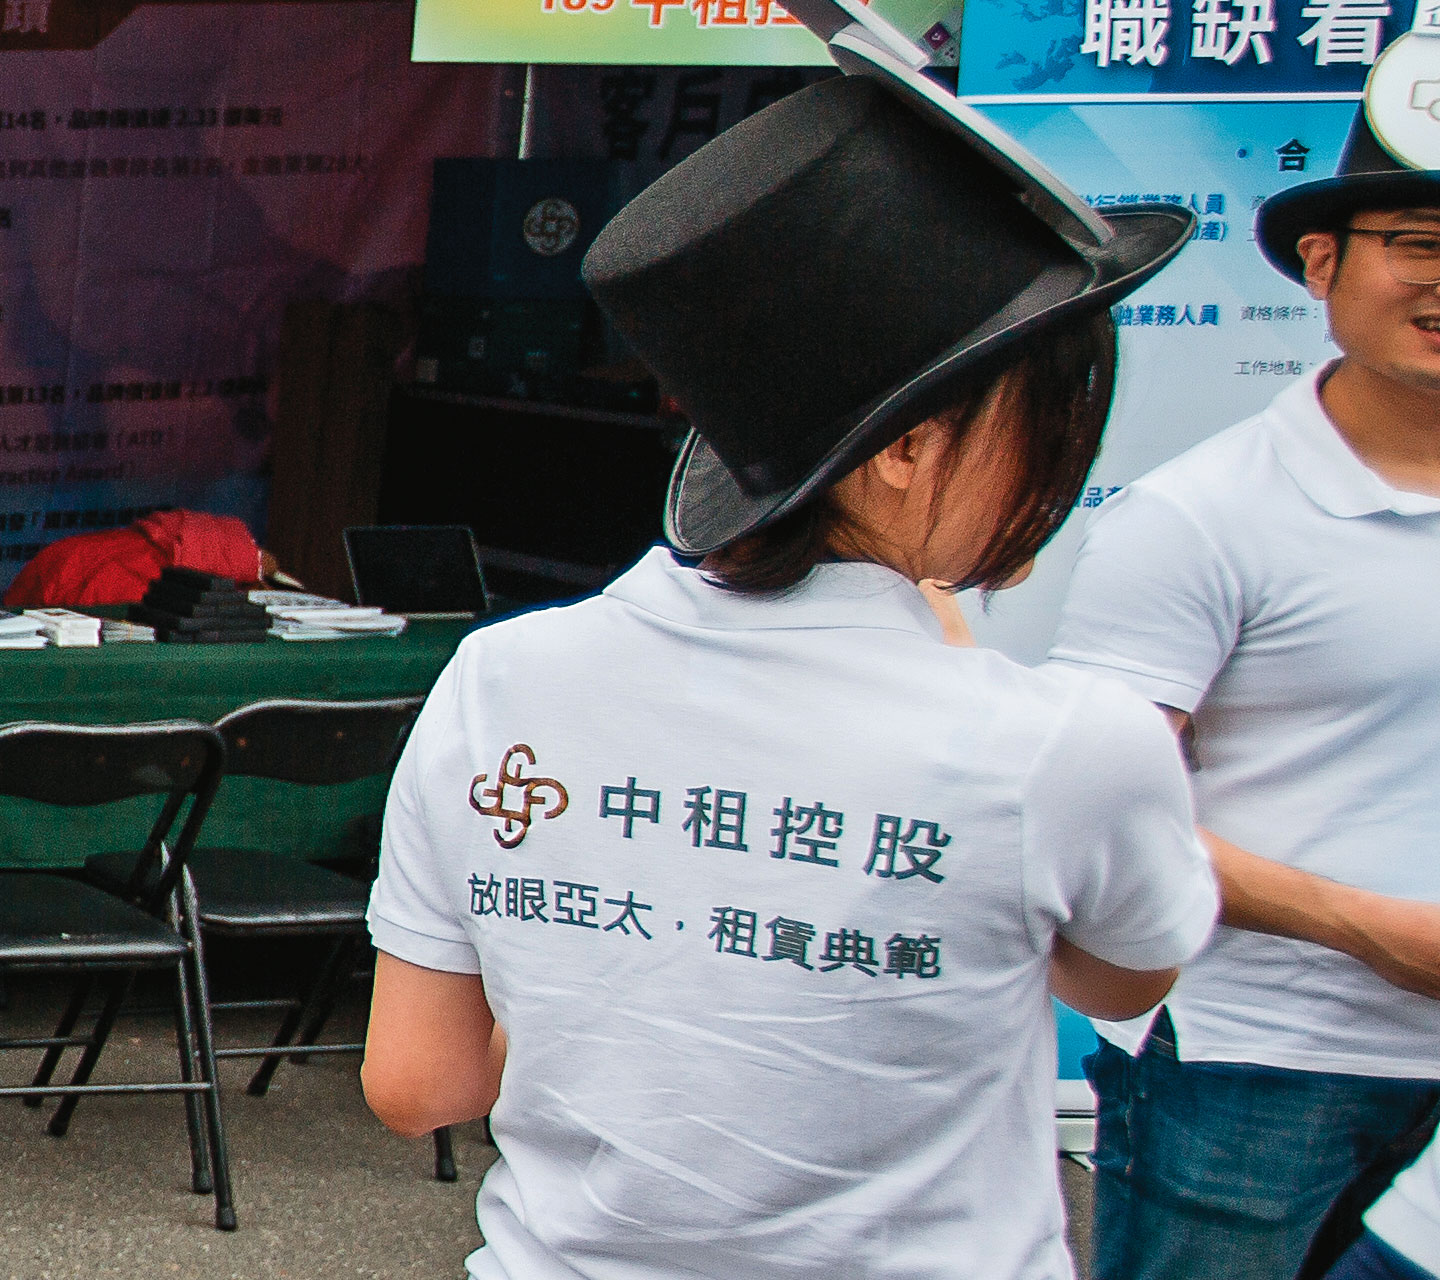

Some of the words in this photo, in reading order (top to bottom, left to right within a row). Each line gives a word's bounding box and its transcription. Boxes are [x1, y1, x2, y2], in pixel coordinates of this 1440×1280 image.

[1276, 138, 1310, 172] 合
[599, 776, 952, 884] 中租控股
